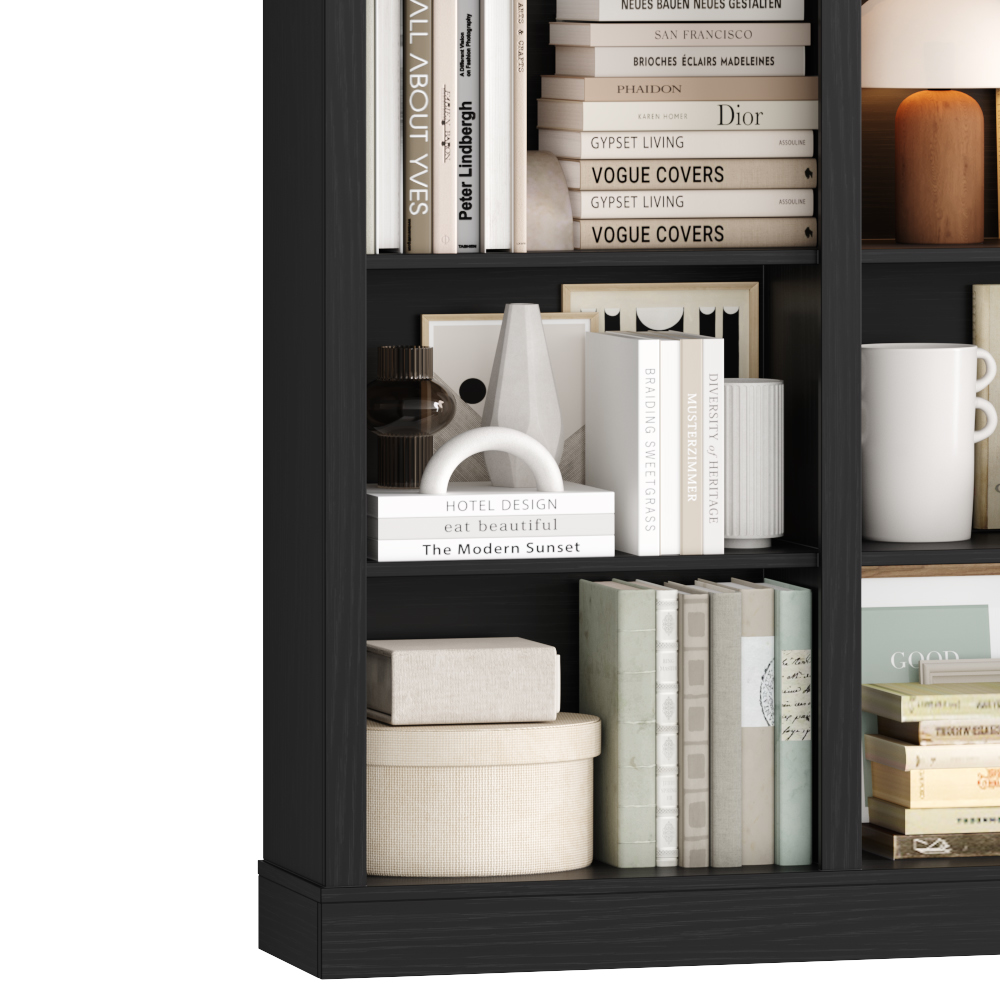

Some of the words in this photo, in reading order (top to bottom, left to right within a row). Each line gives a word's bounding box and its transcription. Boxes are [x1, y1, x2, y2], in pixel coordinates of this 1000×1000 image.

[622, 0, 653, 10] NEUES
[657, 0, 690, 10] BAUEN
[634, 57, 677, 66] BRIOCHES
[682, 54, 716, 66] ÉCLAIRS
[720, 57, 774, 66] MADELEINES
[409, 54, 428, 142] ABOUT
[617, 85, 682, 94] PHAIDON
[717, 104, 764, 126] Dior
[459, 102, 476, 178] Lindbergh
[591, 137, 638, 149] GYPSET
[643, 136, 684, 148] LIVING
[409, 154, 428, 215] YVES
[592, 167, 650, 184] VOGUE
[656, 166, 724, 183] COVERS
[459, 182, 472, 220] Peter
[645, 368, 656, 434] BRAIDING
[709, 373, 718, 440] DIVERSITY
[687, 393, 698, 502] MUSTERZIMMER
[708, 446, 718, 458] of
[645, 440, 656, 532] SWEETGRASS
[709, 460, 718, 524] HERITAGE
[446, 500, 494, 512] HOTEL
[502, 498, 558, 511] DESIGN
[444, 521, 470, 532] eat
[478, 518, 558, 532] beautiful
[423, 544, 453, 556] The
[458, 542, 520, 555] Modern
[526, 542, 580, 554] Sunset
